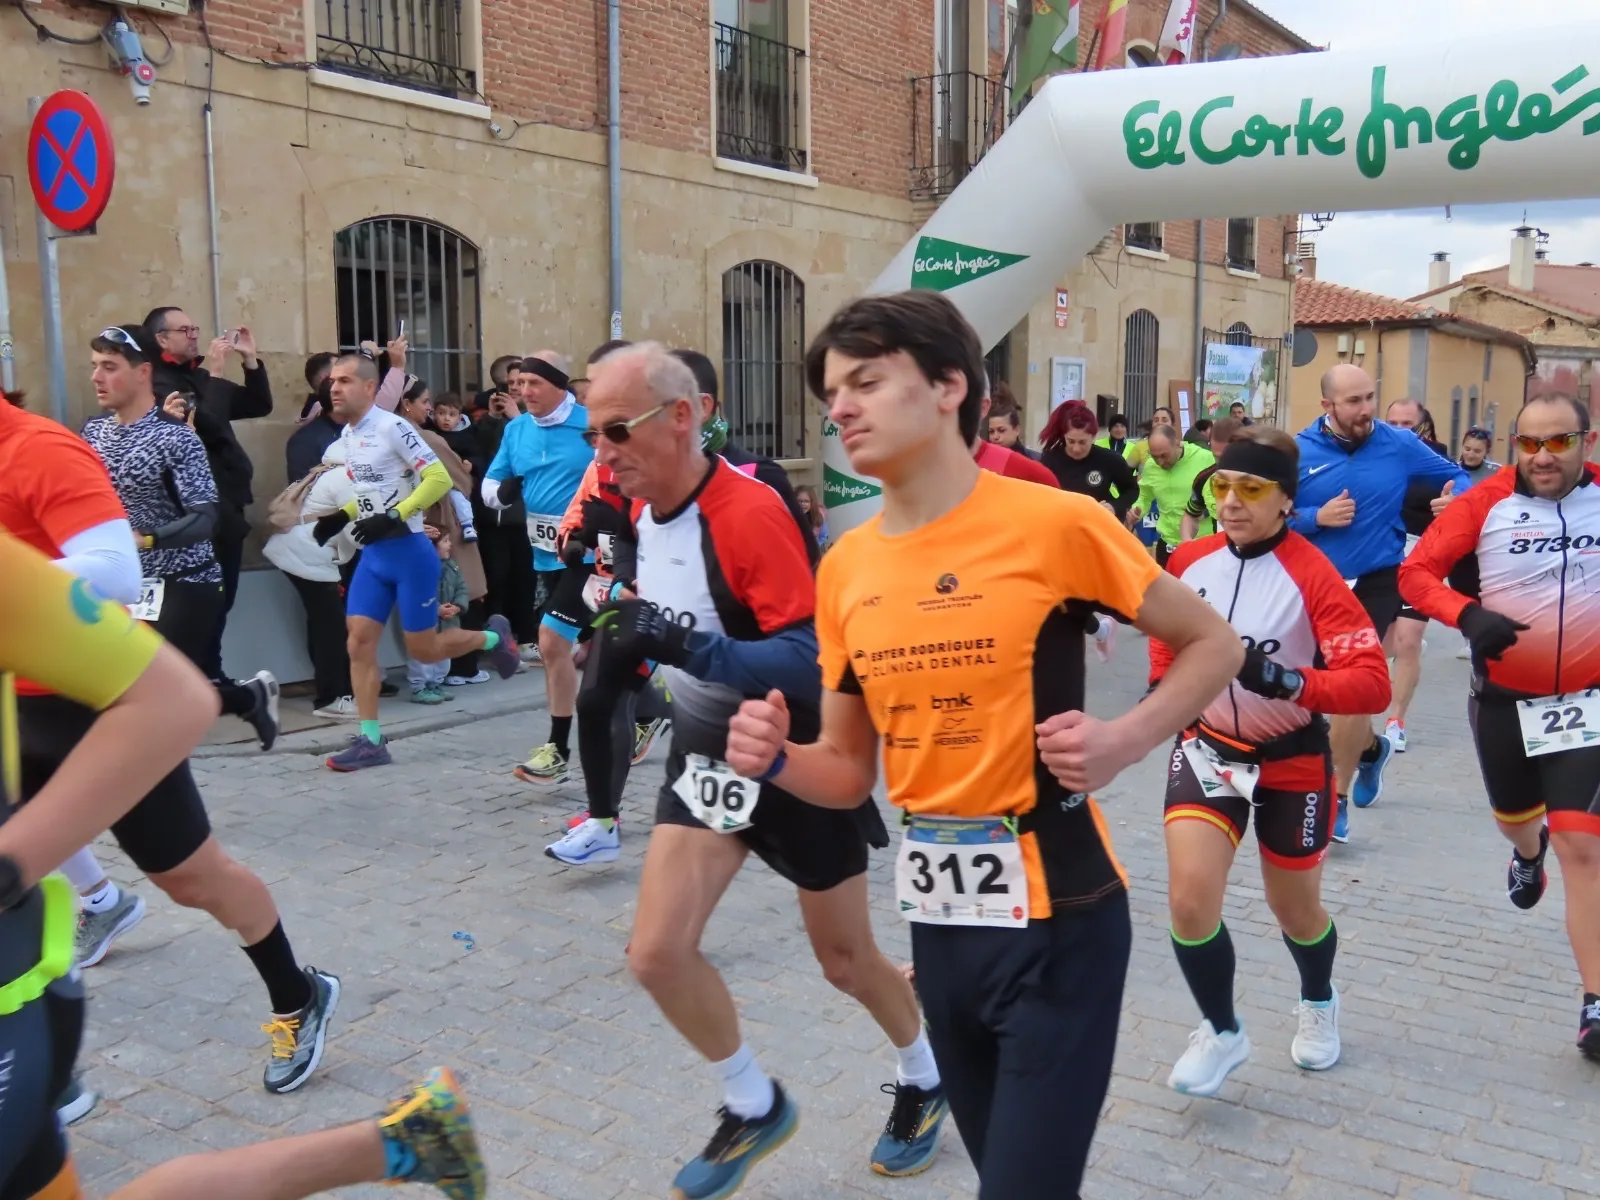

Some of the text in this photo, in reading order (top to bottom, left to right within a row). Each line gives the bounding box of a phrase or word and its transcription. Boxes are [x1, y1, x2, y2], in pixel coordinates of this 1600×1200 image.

[1122, 100, 1186, 170] El
[1189, 96, 1346, 165] Corte
[914, 252, 1000, 275] El Corte Inglés
[536, 524, 557, 541] 50
[1509, 535, 1600, 554] 3730
[871, 638, 995, 662] ESTER RODRÍGUEZ
[872, 653, 996, 677] CLÍNICA DENTAL
[1541, 706, 1586, 735] 22
[1302, 792, 1318, 847] 37300
[908, 850, 1009, 894] 312
